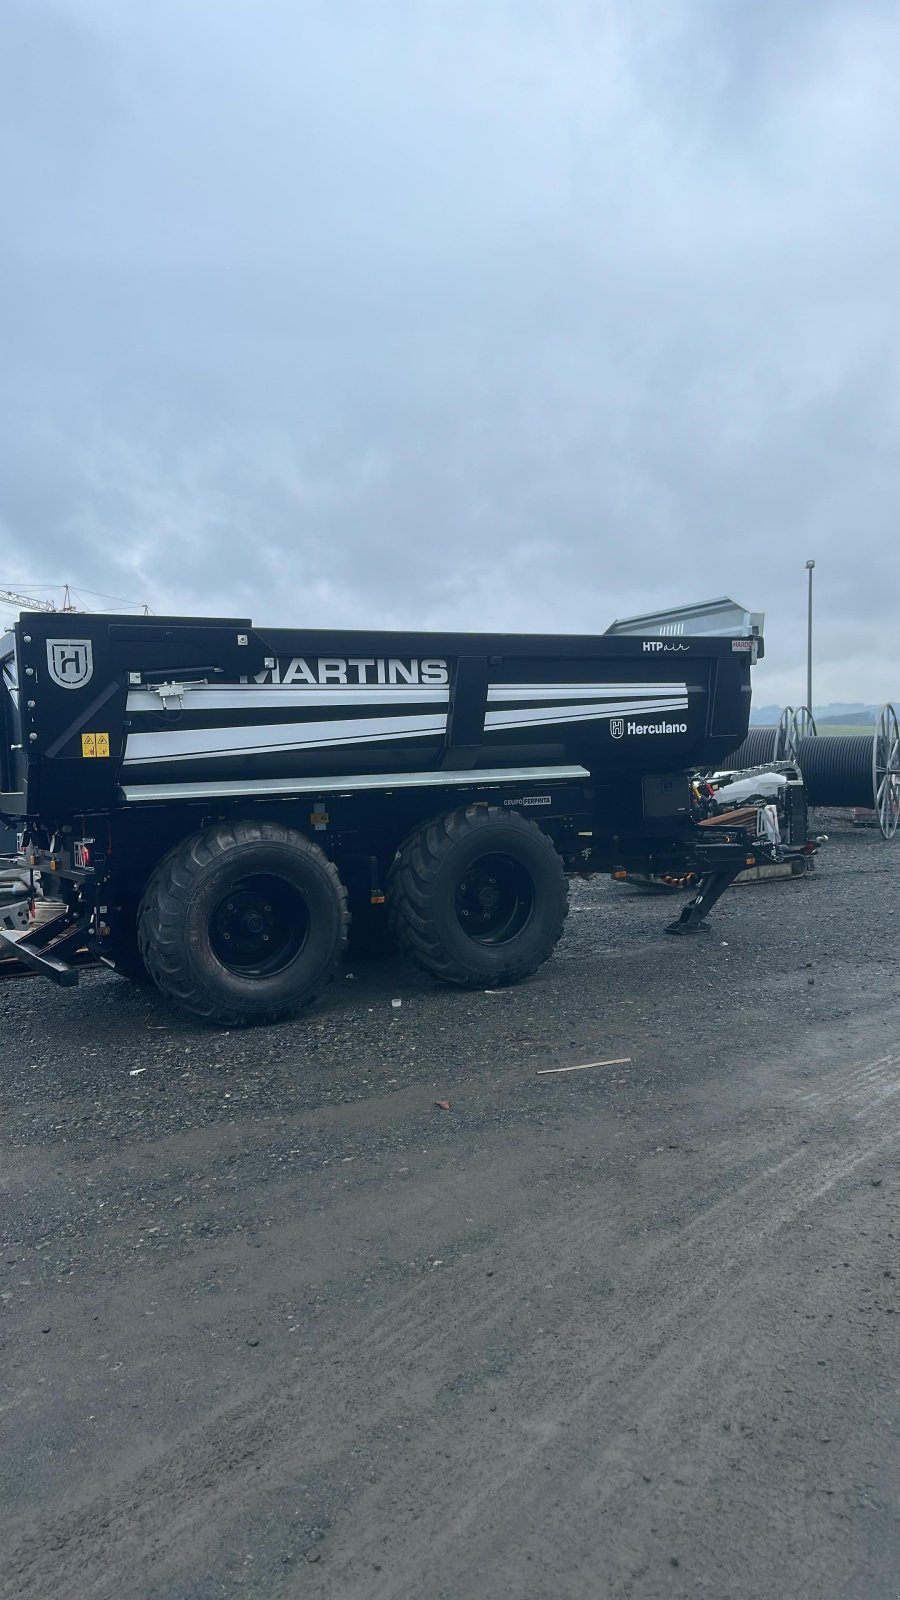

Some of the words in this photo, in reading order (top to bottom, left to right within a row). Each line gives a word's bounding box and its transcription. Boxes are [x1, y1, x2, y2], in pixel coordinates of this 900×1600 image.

[733, 641, 753, 649] HARDO
[627, 721, 688, 735] Herculano
[503, 798, 523, 806] GRUPO
[523, 797, 551, 805] FERPINTA
